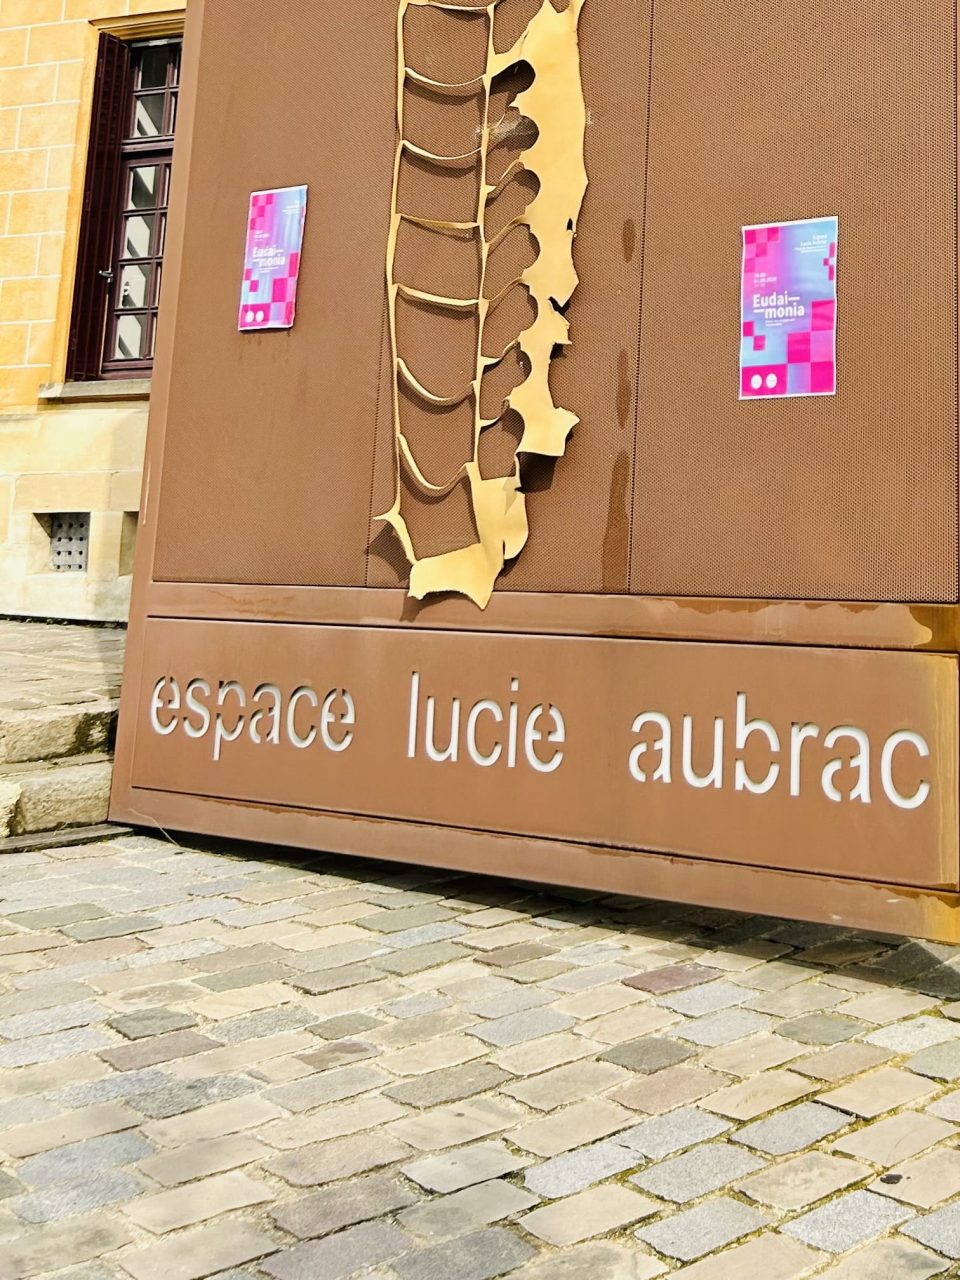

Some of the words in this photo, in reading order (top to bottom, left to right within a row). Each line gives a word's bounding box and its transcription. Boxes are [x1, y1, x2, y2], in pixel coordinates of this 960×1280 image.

[149, 675, 356, 761] espace
[406, 670, 566, 773] lucie
[628, 691, 931, 811] aubrac
